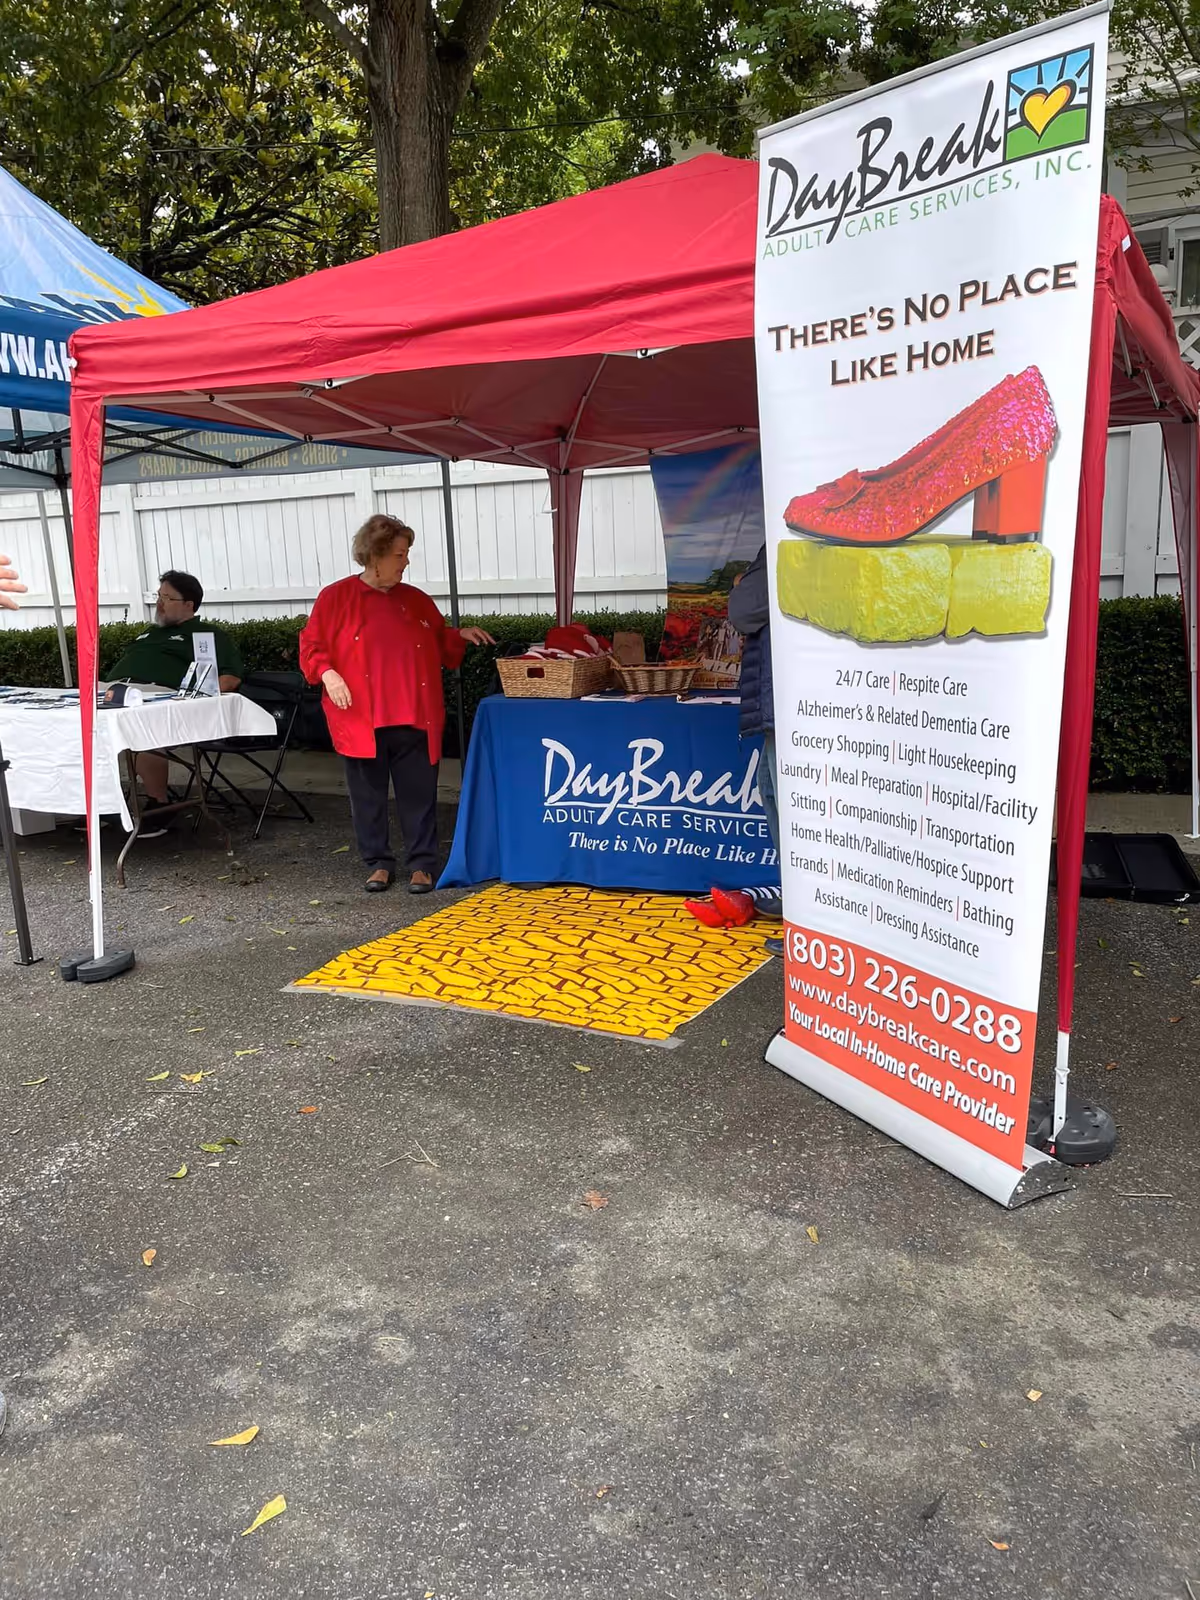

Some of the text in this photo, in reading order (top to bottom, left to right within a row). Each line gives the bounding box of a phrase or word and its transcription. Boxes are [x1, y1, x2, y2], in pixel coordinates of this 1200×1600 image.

[765, 79, 1002, 244] DayBreak
[763, 150, 1092, 260] ADULT CARE SERVICES, INC.
[768, 261, 1078, 352] THERE'S NO PLACE
[830, 329, 995, 386] LIKE HOME
[835, 669, 968, 697] 24/7 Care Respite Care
[797, 699, 1010, 740] Alzheimer's & Related Dementia Care
[780, 758, 1038, 825] Laundry Meal Preparation Hospital/Facility
[791, 730, 1017, 784] Grocery Shopping Light Housekeeping
[542, 808, 768, 838] ADULT CARE SERVICE
[569, 831, 608, 852] There
[614, 834, 628, 852] is
[633, 836, 658, 854] No
[663, 838, 710, 858] Place
[715, 843, 755, 865] Like
[791, 791, 1015, 856] Sitting Companionship Transportation
[791, 822, 1014, 894] Home Health/Palliative/Hospice Support
[790, 851, 1014, 937] Errands Medication Reminders Bathing
[815, 887, 980, 959] Assistance Dressing Assistance
[786, 926, 1023, 1053] (803) 226-0288
[789, 973, 1017, 1095] www.daybreakcare.com
[789, 1001, 1016, 1136] Your Local In-Home Care Provider
